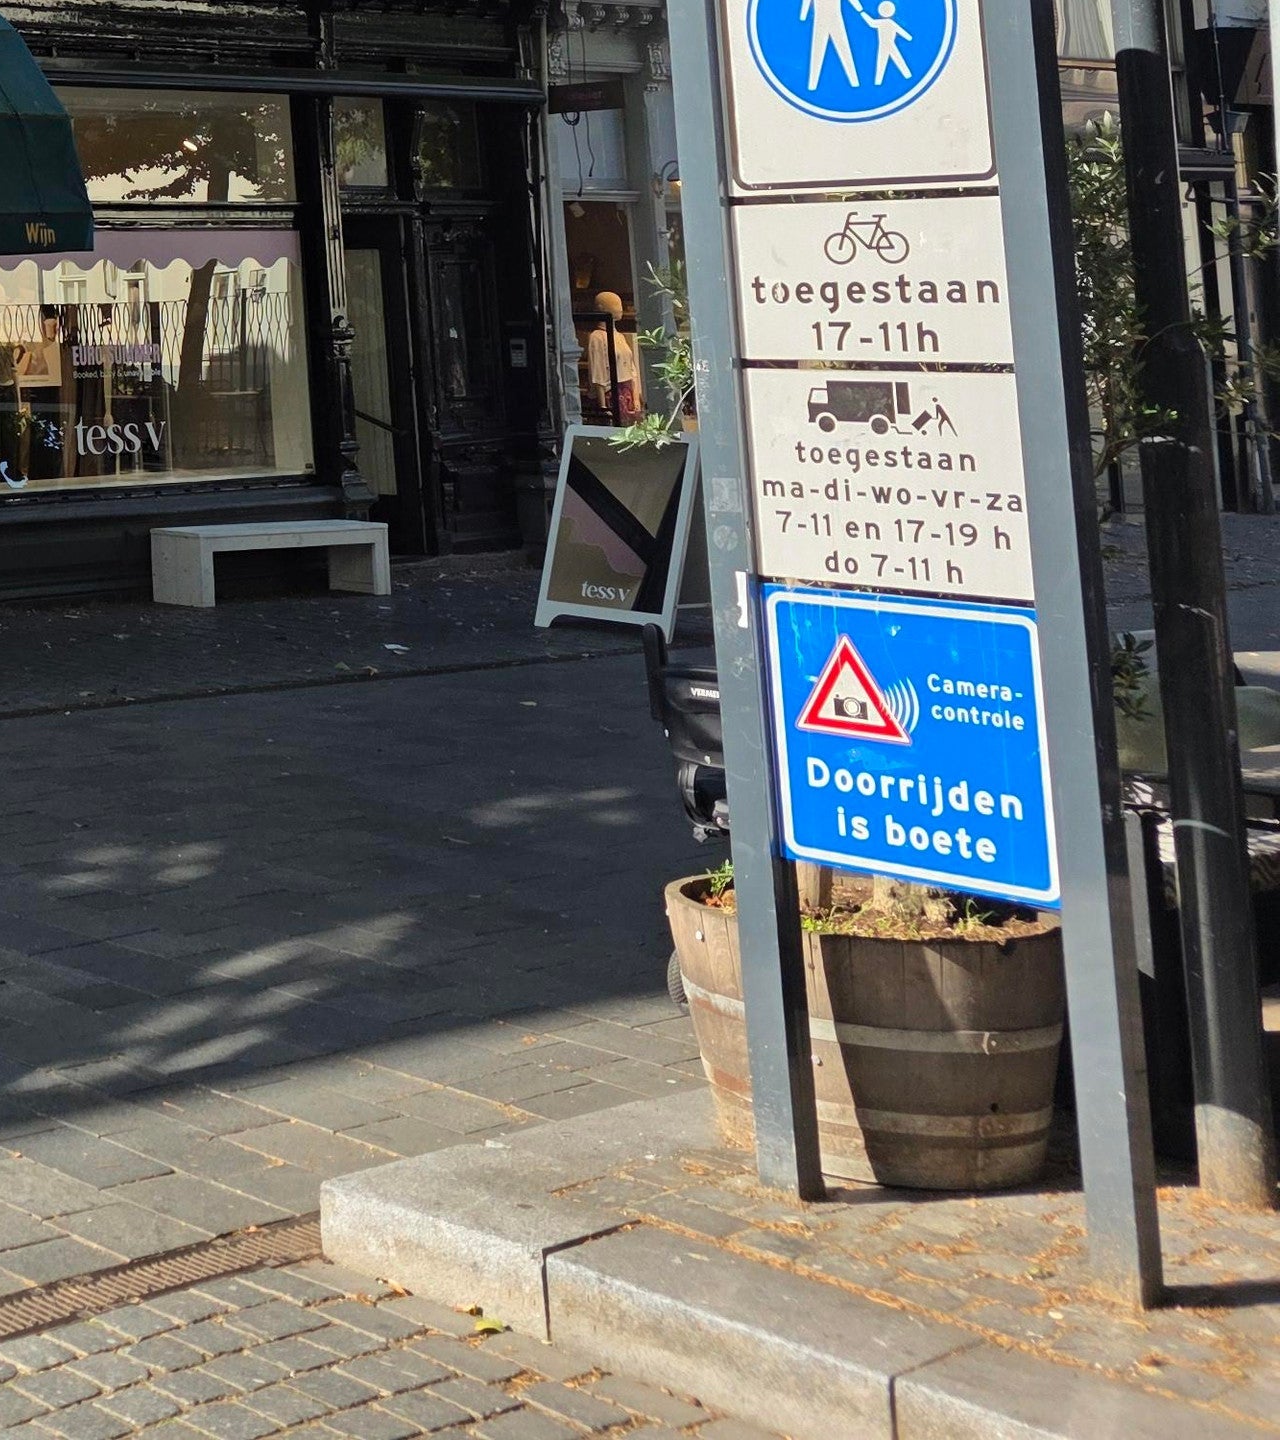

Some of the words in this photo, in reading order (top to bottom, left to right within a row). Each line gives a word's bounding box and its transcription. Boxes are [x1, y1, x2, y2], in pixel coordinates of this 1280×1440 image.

[25, 221, 57, 247] Wijn
[751, 273, 1001, 314] toegestaan
[74, 415, 142, 456] tess
[144, 420, 166, 452] v
[794, 440, 977, 474] toegestaan
[762, 478, 1023, 513] ma-di-wo-vr-za
[775, 510, 832, 538] 7-11
[844, 519, 881, 541] en
[894, 518, 978, 547] 17-19
[994, 525, 1012, 550] h
[824, 550, 859, 576] do
[870, 553, 931, 584] 7-11
[946, 559, 964, 585] h
[580, 580, 615, 601] tess
[926, 673, 1024, 702] Camera-
[931, 702, 1025, 731] controle
[806, 757, 1024, 820] Doorrijden
[836, 806, 870, 840] is
[885, 815, 997, 863] boete
